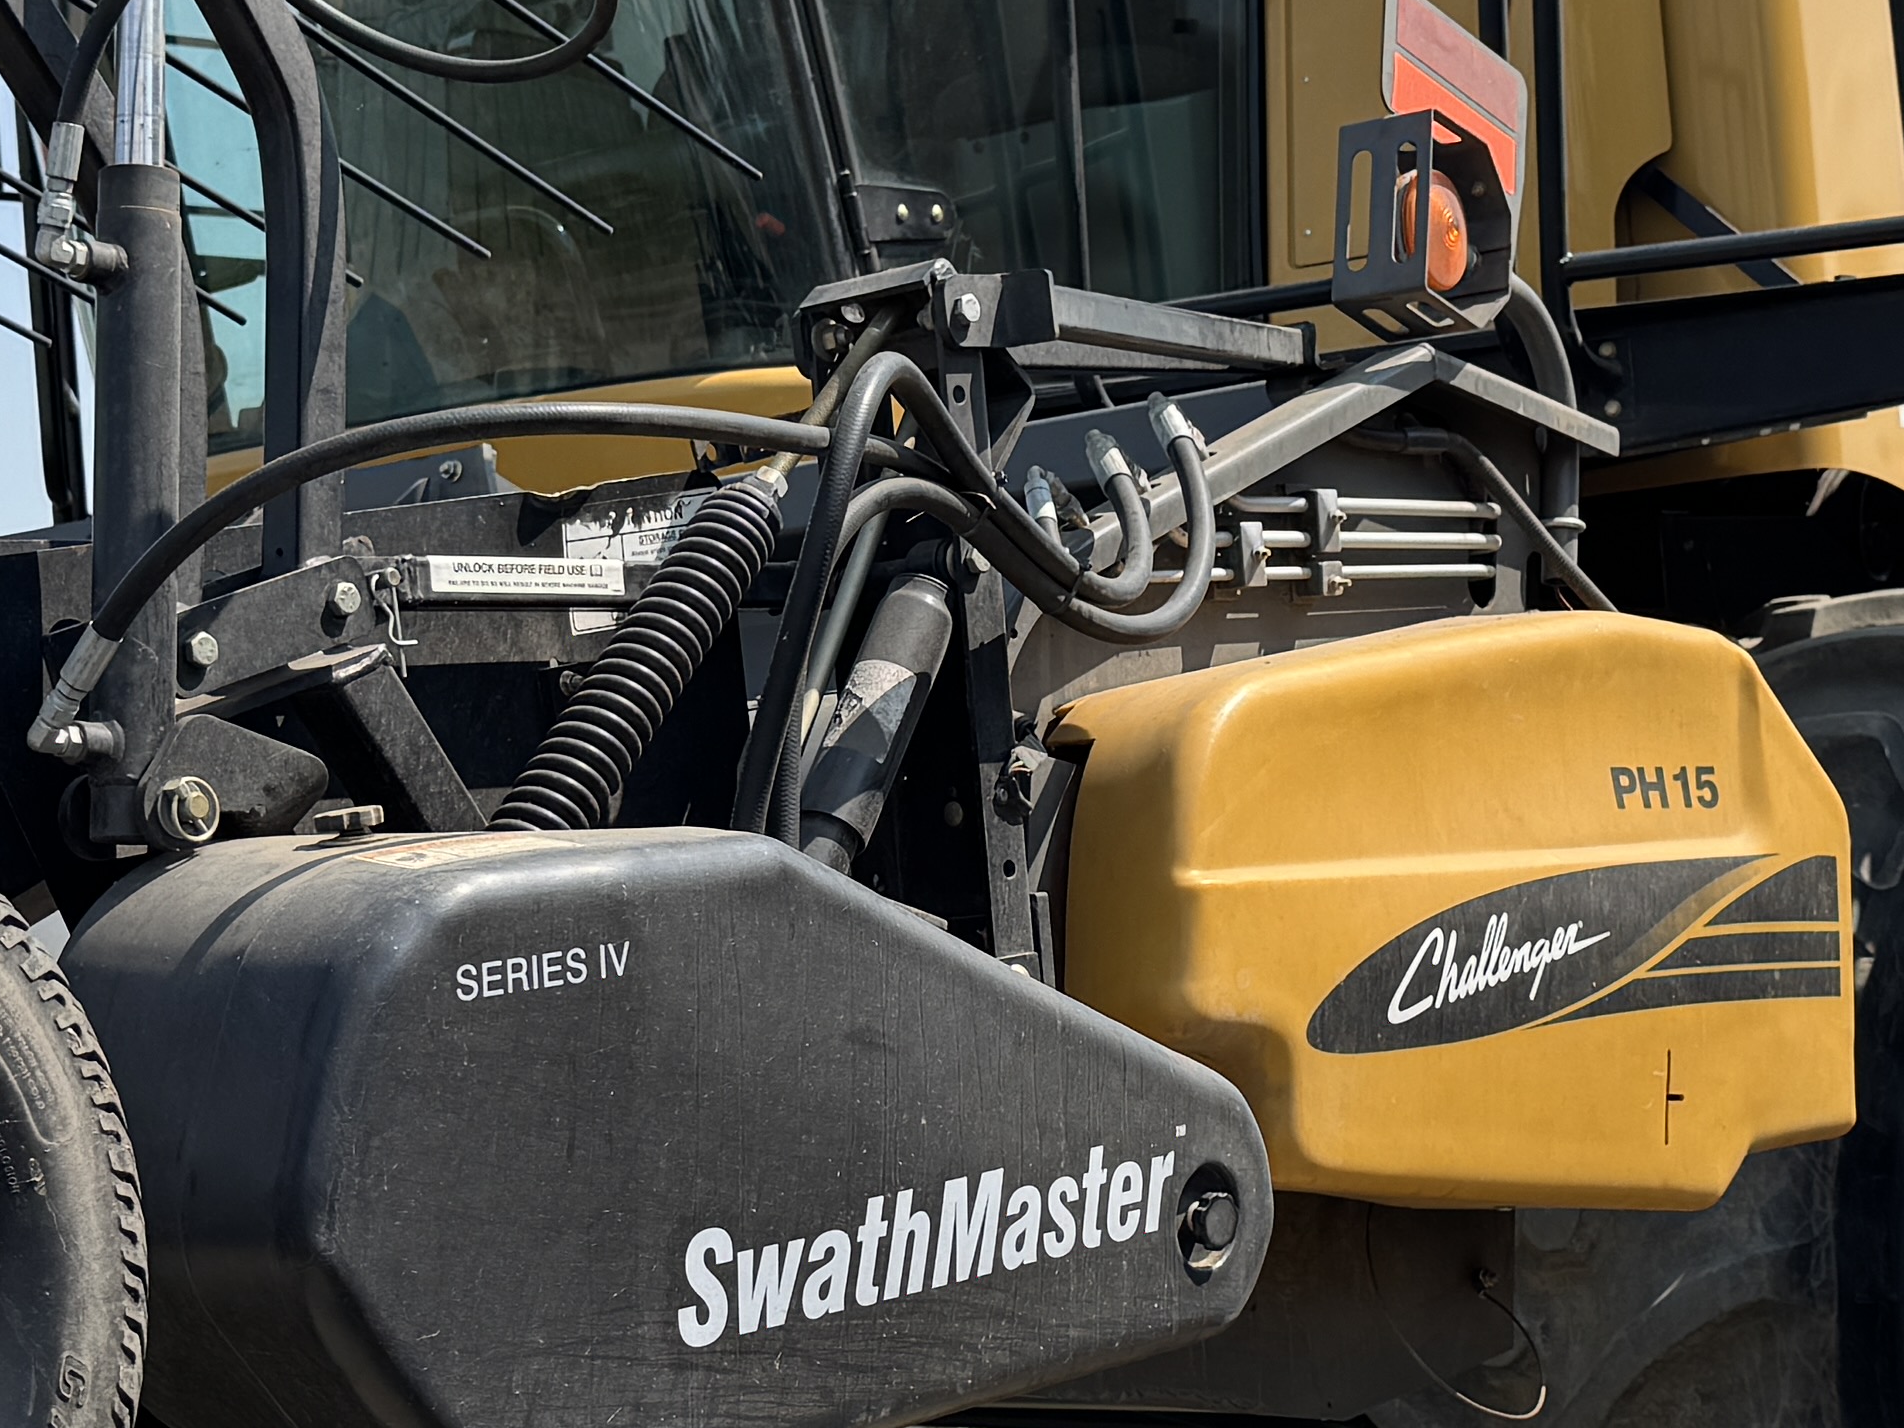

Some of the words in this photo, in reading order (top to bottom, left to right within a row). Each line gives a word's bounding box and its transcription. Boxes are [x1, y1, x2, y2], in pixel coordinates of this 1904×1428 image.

[452, 562, 495, 574] UNLOCK
[497, 563, 536, 574] BEFORE
[538, 564, 565, 575] FIELD
[567, 564, 587, 576] USE
[455, 946, 588, 1002] SERIES
[599, 940, 631, 979] IV
[1387, 911, 1612, 1025] Challenger
[677, 1144, 1175, 1348] SwathMaster
